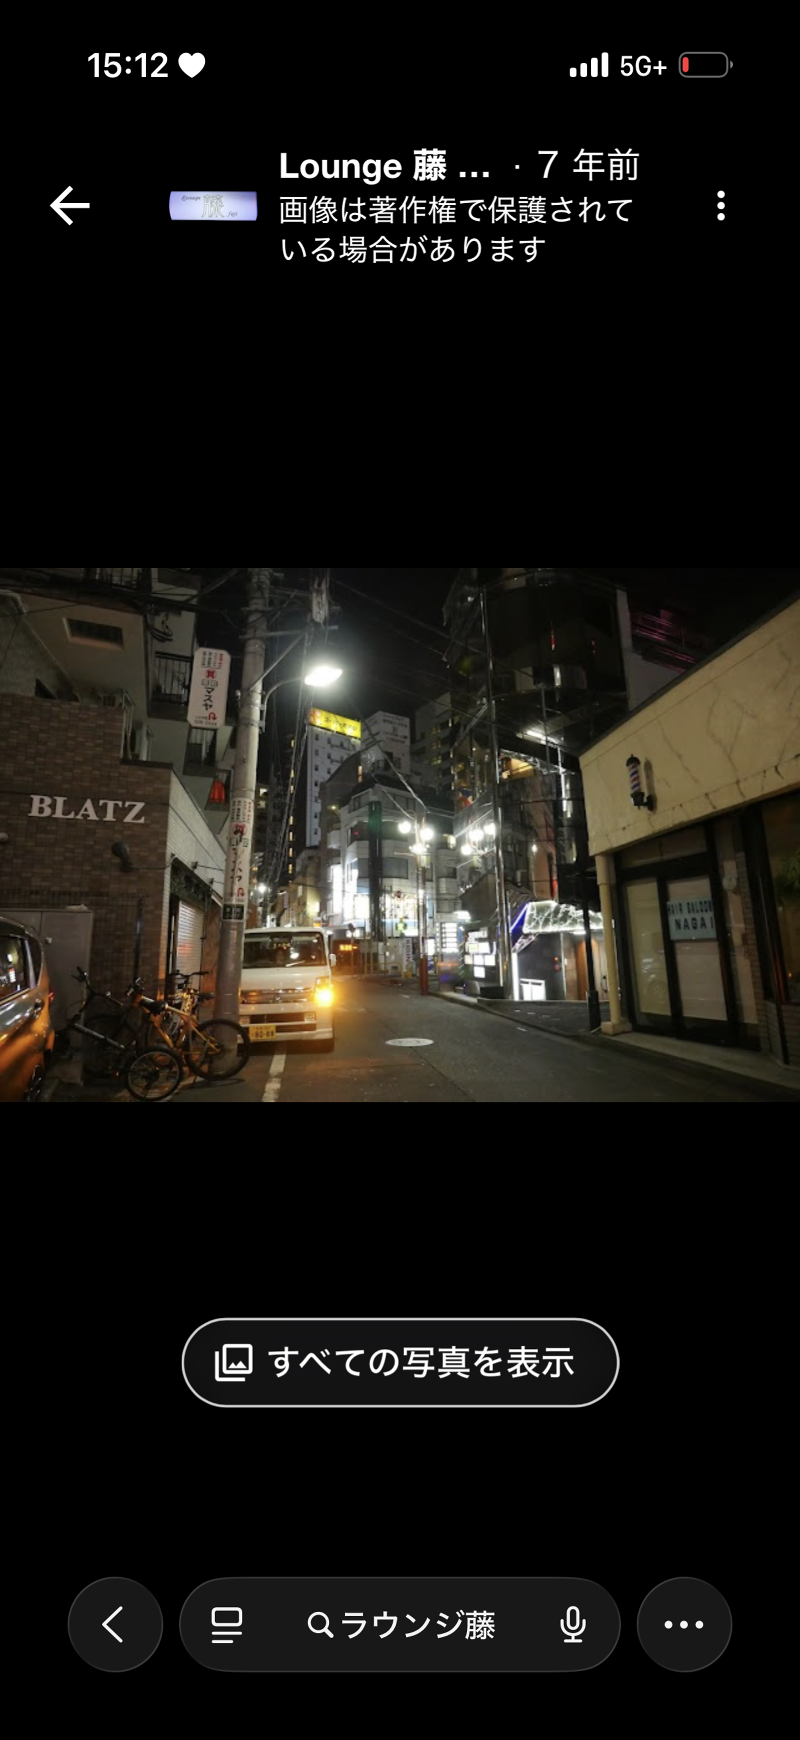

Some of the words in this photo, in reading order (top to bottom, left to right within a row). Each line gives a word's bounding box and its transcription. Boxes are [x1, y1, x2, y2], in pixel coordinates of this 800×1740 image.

[202, 687, 215, 711] マスヤ
[28, 795, 146, 823] BLATZ
[667, 903, 683, 915] HAIR
